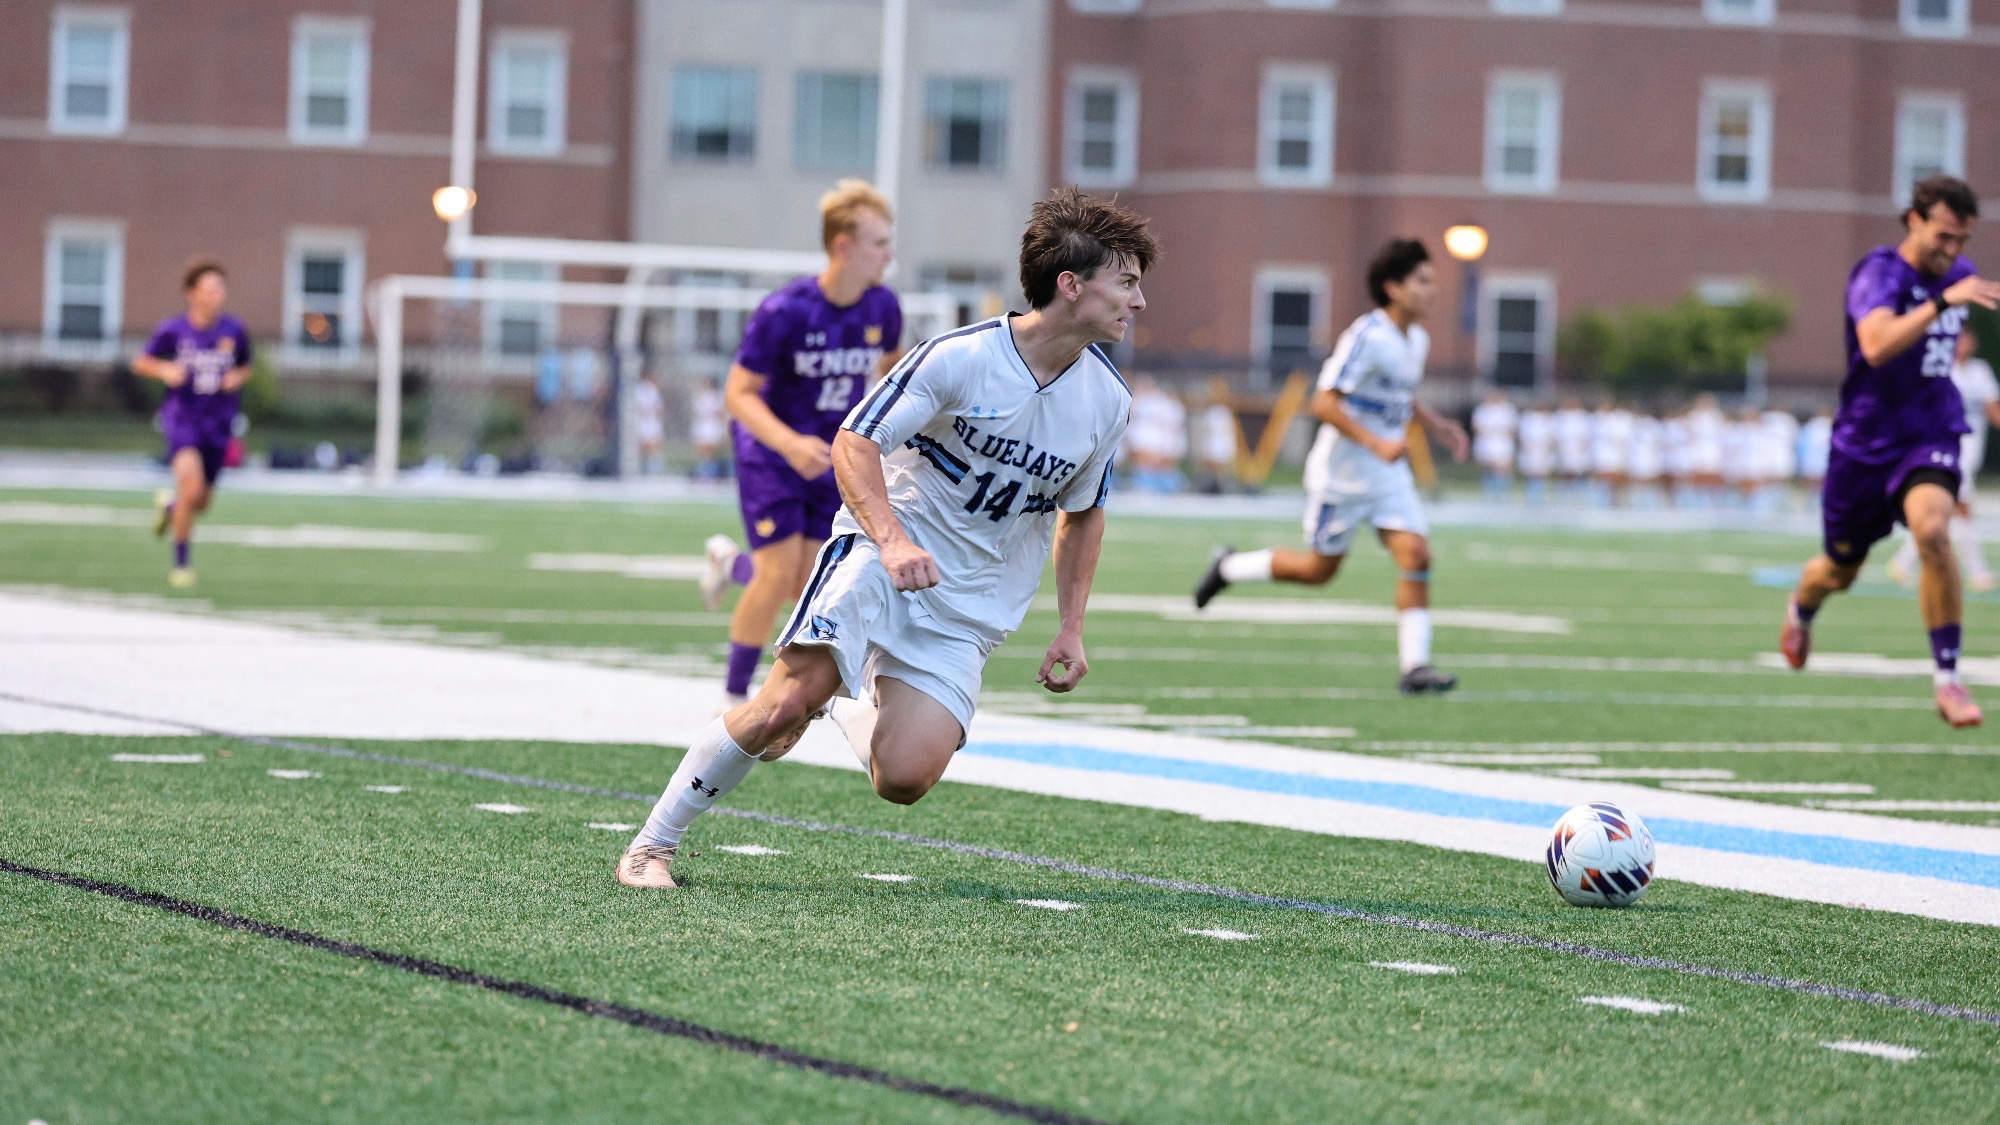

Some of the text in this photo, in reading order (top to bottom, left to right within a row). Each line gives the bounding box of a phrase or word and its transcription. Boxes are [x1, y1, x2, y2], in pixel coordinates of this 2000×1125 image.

[816, 376, 853, 411] 12
[952, 415, 1076, 484] BLUEJAYS
[963, 471, 1023, 522] 14
